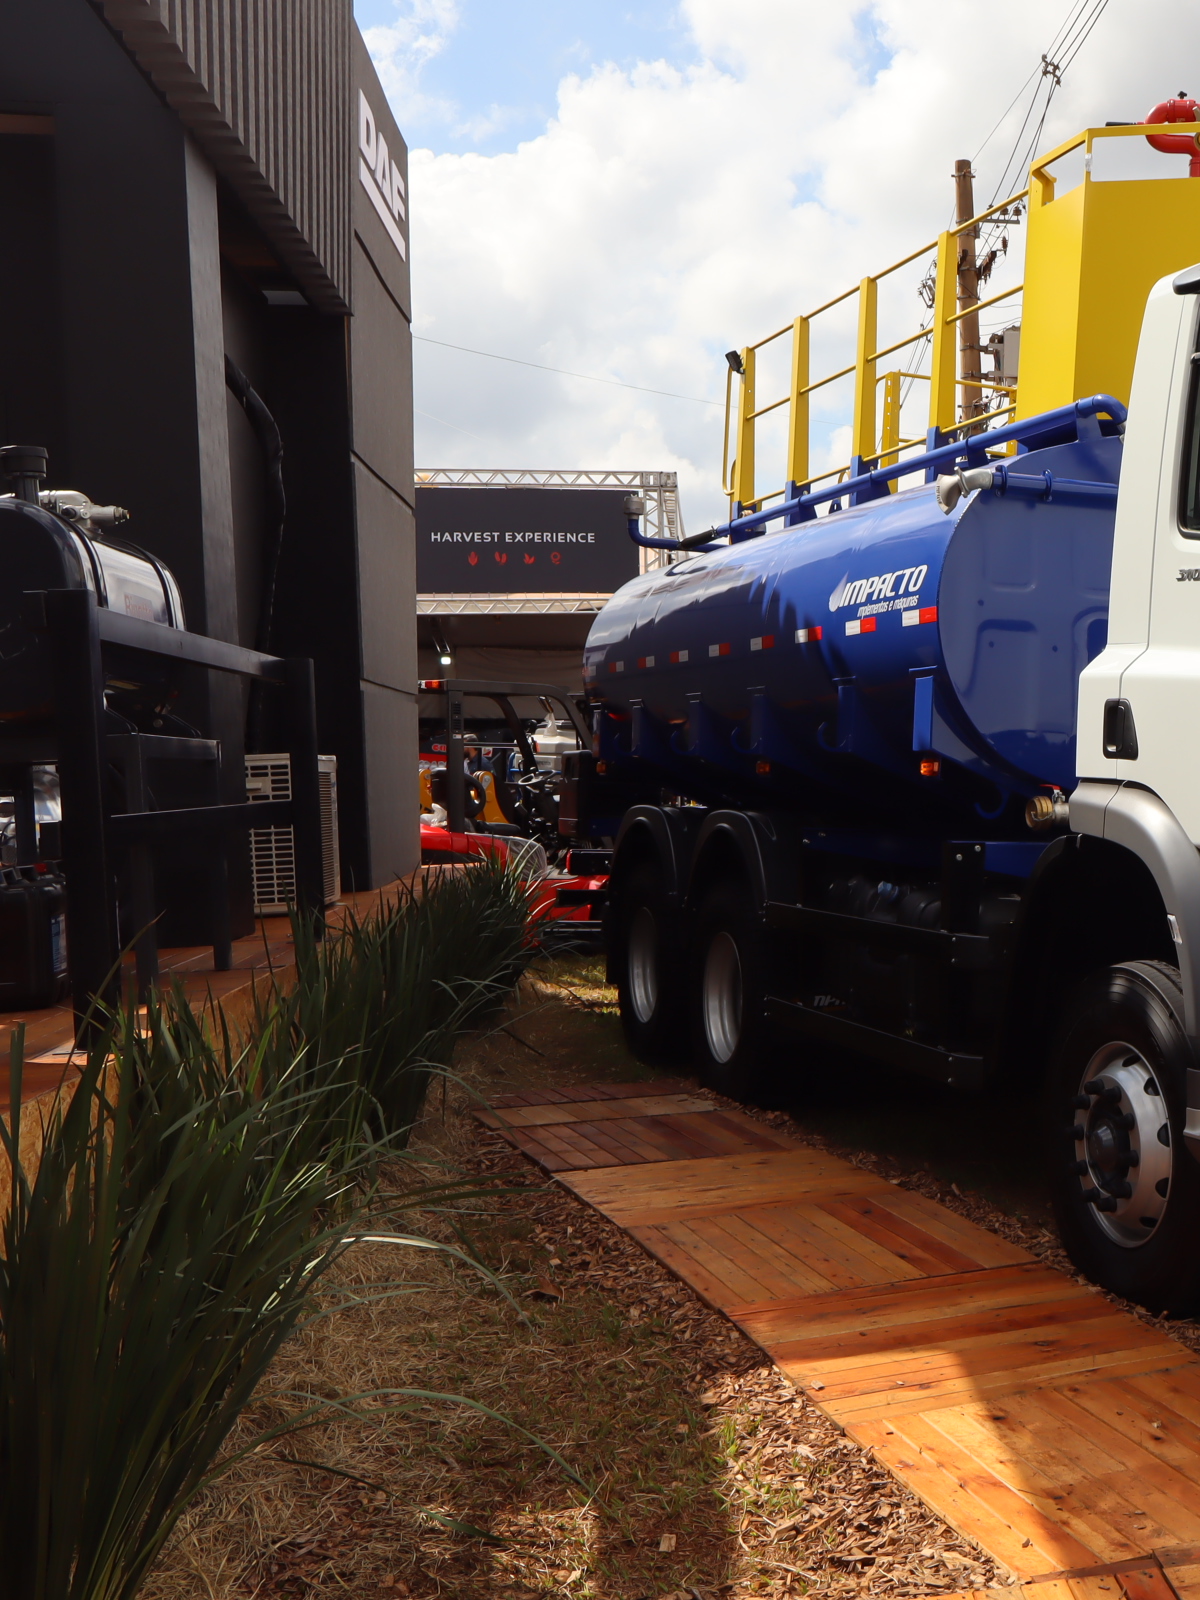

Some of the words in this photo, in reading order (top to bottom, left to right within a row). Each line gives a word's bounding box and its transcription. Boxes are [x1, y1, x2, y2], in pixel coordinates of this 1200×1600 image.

[358, 88, 405, 222] DAF
[431, 532, 500, 543] HARVEST
[505, 532, 596, 543] EXPERIENCE
[838, 564, 928, 608] IMPACTO
[888, 600, 894, 611] e
